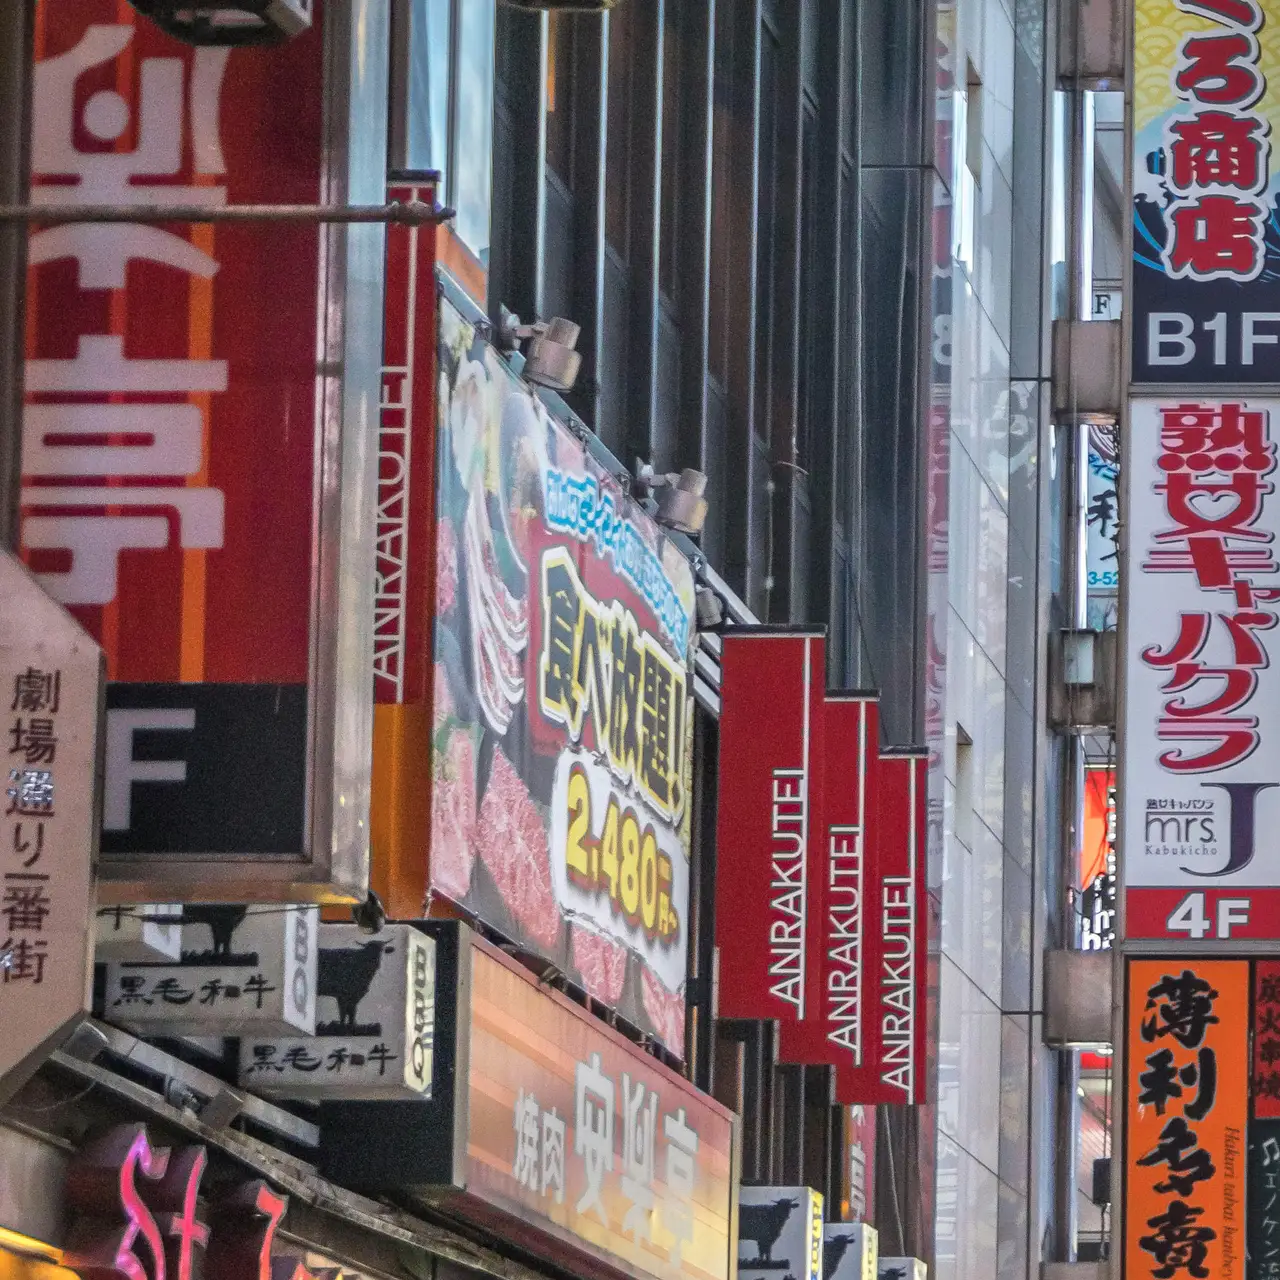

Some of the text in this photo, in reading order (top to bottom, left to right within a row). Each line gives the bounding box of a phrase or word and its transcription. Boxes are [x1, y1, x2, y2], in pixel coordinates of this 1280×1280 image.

[370, 366, 411, 683] ANRAKUTEI
[2, 665, 60, 985] 劇場通り一番街
[768, 768, 806, 1008] ANRAKUTEI
[1144, 844, 1218, 856] Kabukicho
[115, 974, 275, 1008] 黒毛和牛
[828, 824, 862, 1053] ANRAKUTEI
[881, 876, 913, 1091] ANRAKUTEI
[1165, 892, 1252, 939] 4F
[246, 1045, 397, 1073] 黒毛和牛
[513, 1094, 565, 1204] 焼肉
